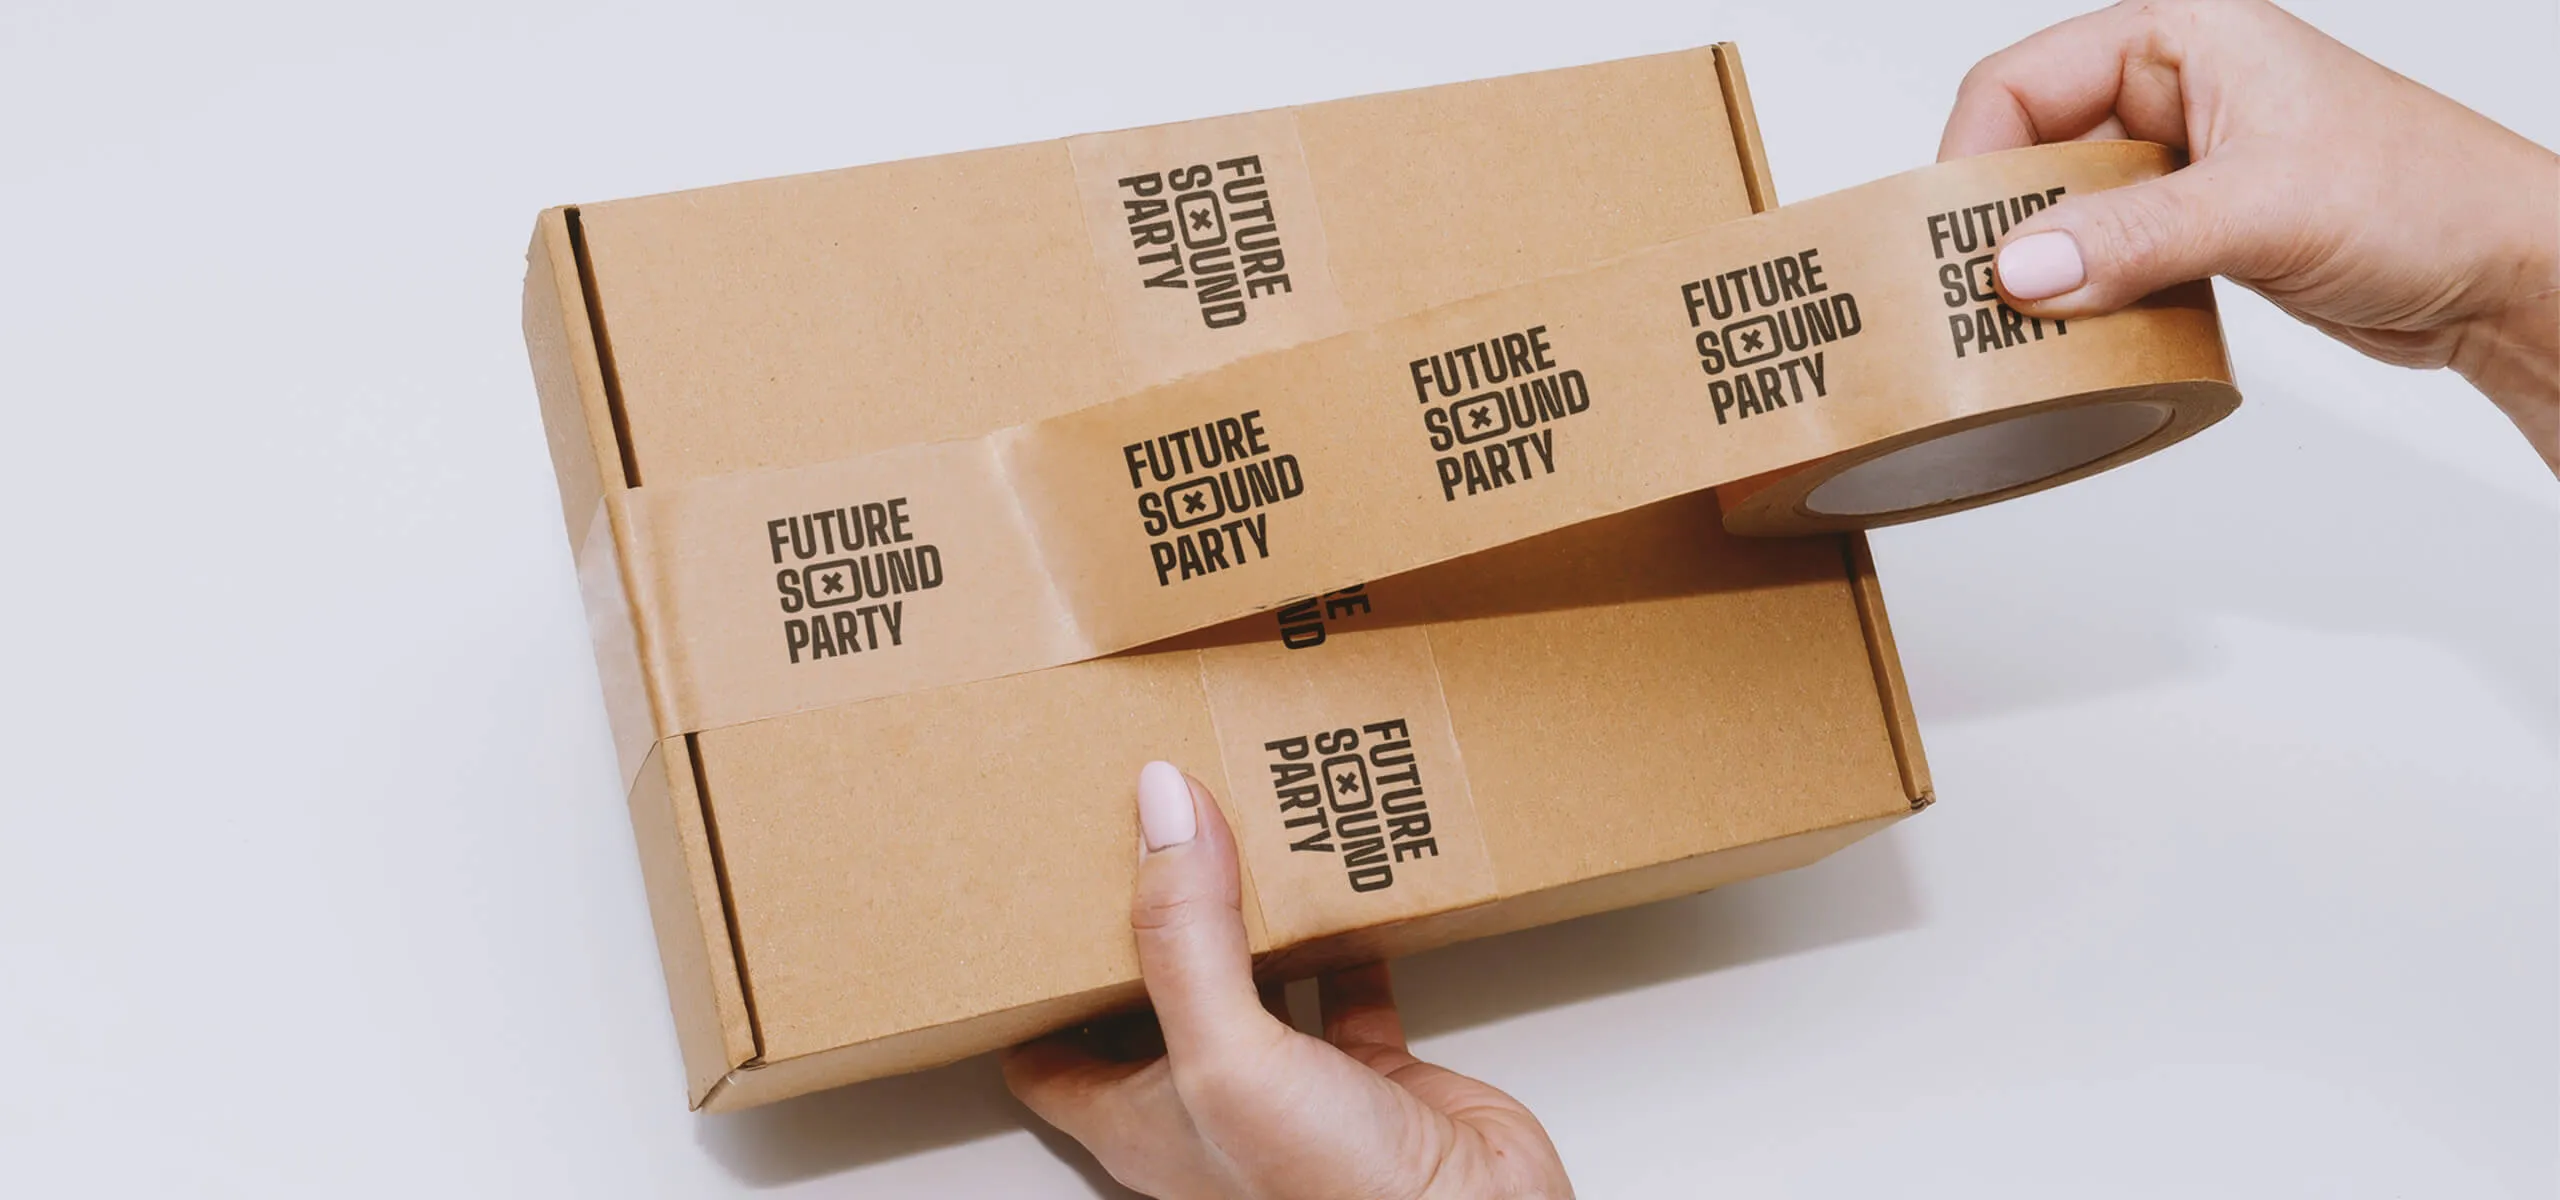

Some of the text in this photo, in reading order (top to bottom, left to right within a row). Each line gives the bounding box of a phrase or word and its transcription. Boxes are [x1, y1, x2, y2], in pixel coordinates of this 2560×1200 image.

[1118, 172, 1189, 289] PARTY
[1168, 164, 1247, 329] SOUND
[1217, 155, 1292, 299] FUTURE
[1681, 248, 1828, 328] FUTURE
[1409, 325, 1557, 405] FUTURE
[1695, 292, 1862, 376] SOUND
[1423, 369, 1590, 453] SOUND
[1707, 351, 1827, 426] PARTY
[1122, 409, 1271, 490] FUTURE
[1435, 428, 1555, 502] PARTY
[767, 497, 914, 564] FUTURE
[1137, 454, 1305, 537] SOUND
[776, 544, 943, 614] SOUND
[1149, 512, 1270, 587] PARTY
[784, 600, 903, 664] PARTY
[1264, 735, 1336, 853] PARTY
[1314, 727, 1394, 893] SOUND
[1362, 718, 1439, 863] FUTURE
